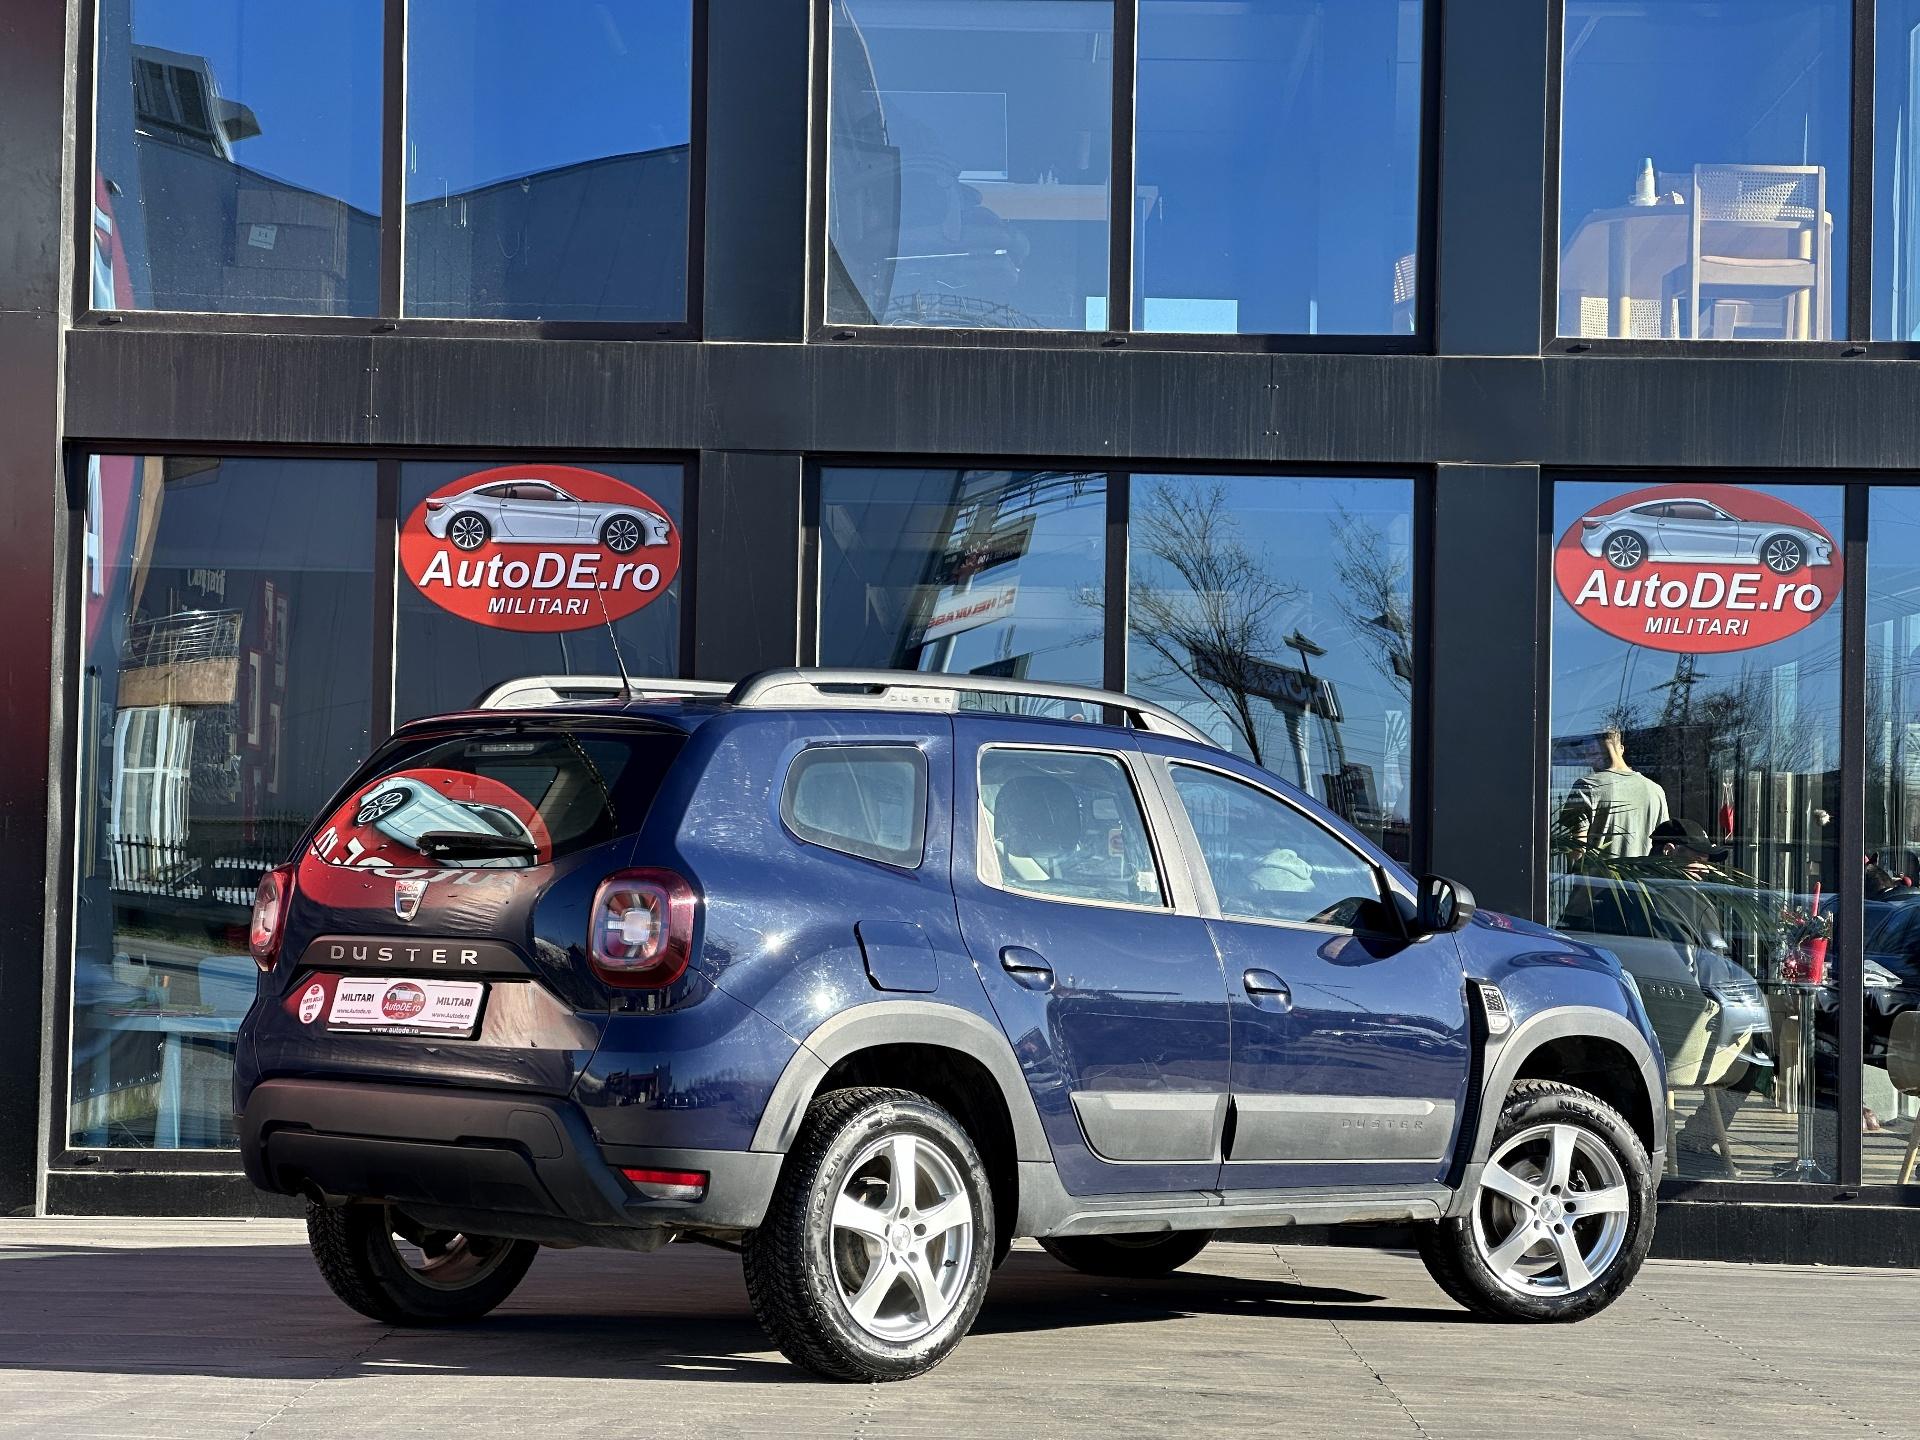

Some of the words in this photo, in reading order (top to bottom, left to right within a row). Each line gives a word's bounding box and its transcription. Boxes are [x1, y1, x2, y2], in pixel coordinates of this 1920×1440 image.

[418, 550, 661, 592] AutoDE.ro
[1575, 569, 1824, 613] AutoDE.ro
[487, 597, 590, 616] MILITARI
[1644, 616, 1750, 637] MILITARI
[889, 694, 952, 705] DUSTER
[397, 884, 419, 893] DACIA
[330, 944, 478, 966] DUSTER
[340, 993, 375, 1003] MILITARI
[435, 996, 474, 1008] MILITARI
[382, 1001, 422, 1012] AutoDE.ro
[371, 1026, 420, 1036] www.autode.ro
[1557, 1099, 1617, 1132] NEXEN
[1342, 1118, 1424, 1130] DUSTER
[811, 1152, 845, 1230] NEXEN
